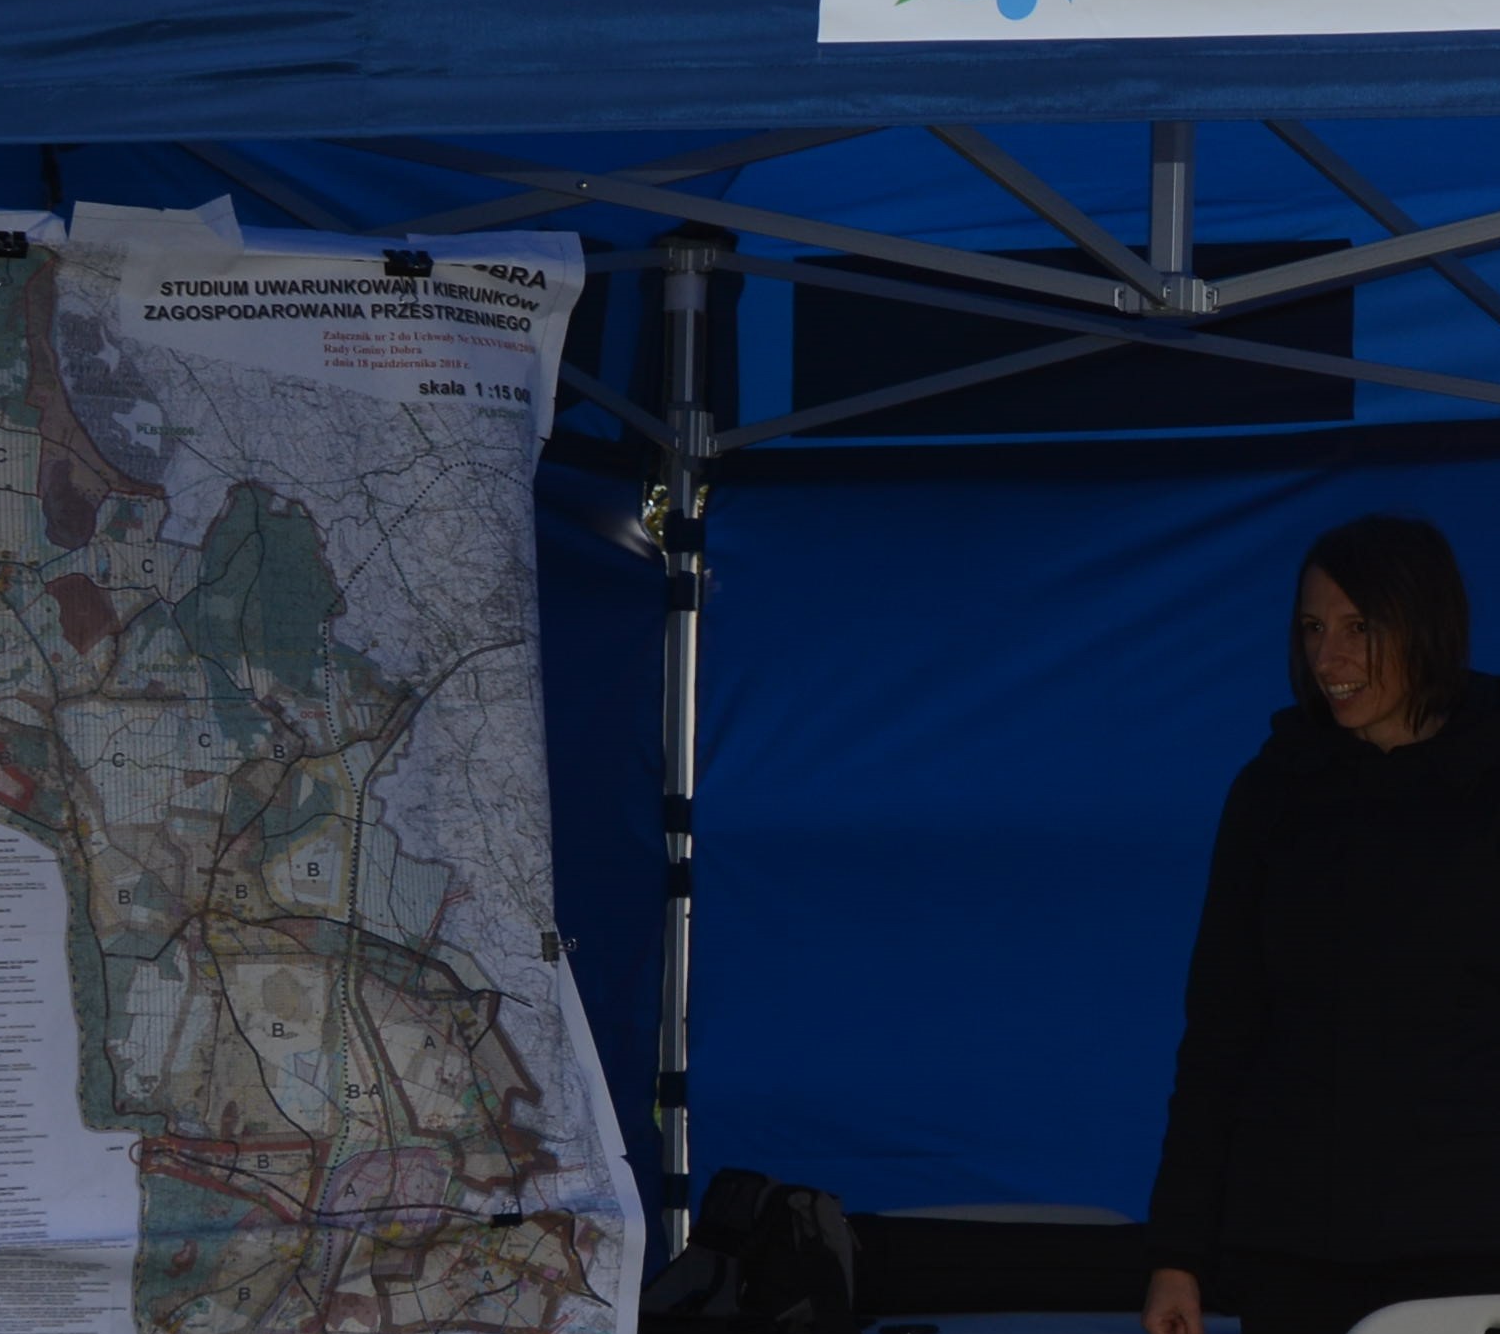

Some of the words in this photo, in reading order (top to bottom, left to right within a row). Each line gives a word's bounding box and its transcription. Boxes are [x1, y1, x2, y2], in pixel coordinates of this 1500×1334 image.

[160, 280, 248, 297] STUDIUM
[433, 281, 539, 312] KIERUNKÓW
[144, 304, 365, 320] ZAGOSPODAROWANIA
[372, 303, 531, 334] PRZESTRZENNEGO
[323, 331, 370, 341] Załącznik
[389, 332, 395, 341] 2
[398, 332, 411, 341] do
[414, 332, 454, 344] Uchwały
[324, 344, 350, 355] Rady
[353, 345, 386, 356] Gminy
[390, 345, 422, 355] Dobra
[333, 358, 354, 367] dnia
[357, 358, 368, 368] 18
[419, 380, 466, 396] skala
